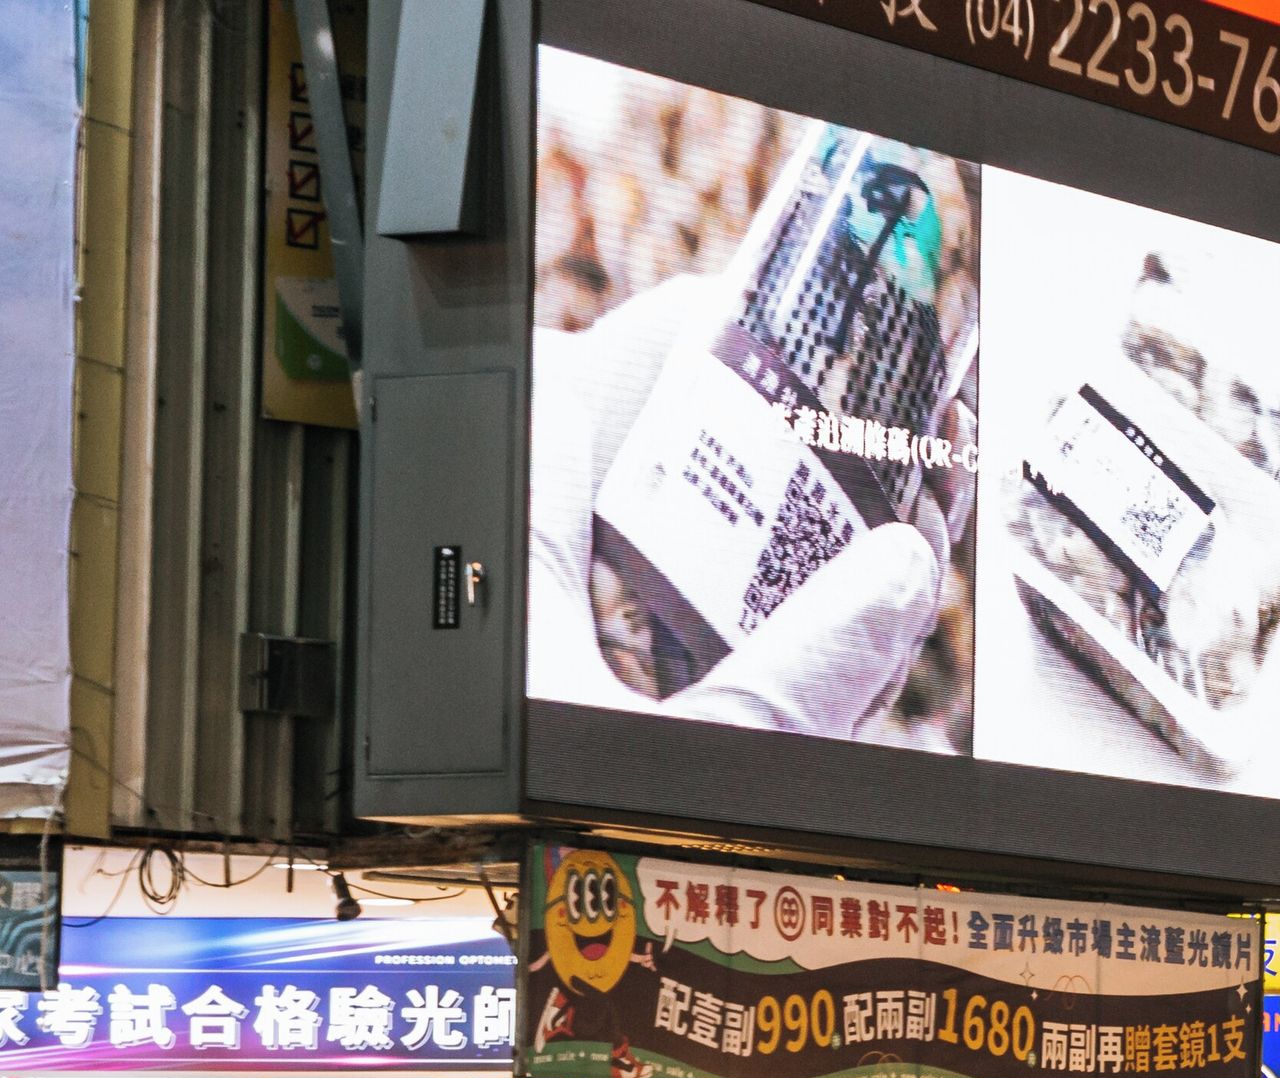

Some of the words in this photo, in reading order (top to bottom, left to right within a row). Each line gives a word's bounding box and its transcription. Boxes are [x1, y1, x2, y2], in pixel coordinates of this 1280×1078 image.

[655, 878, 768, 930] 不解釋了
[811, 895, 959, 946] 同業對不起!
[967, 910, 1253, 971] 全面升級市場主流藍光鏡片
[375, 954, 455, 965] PROFESSION
